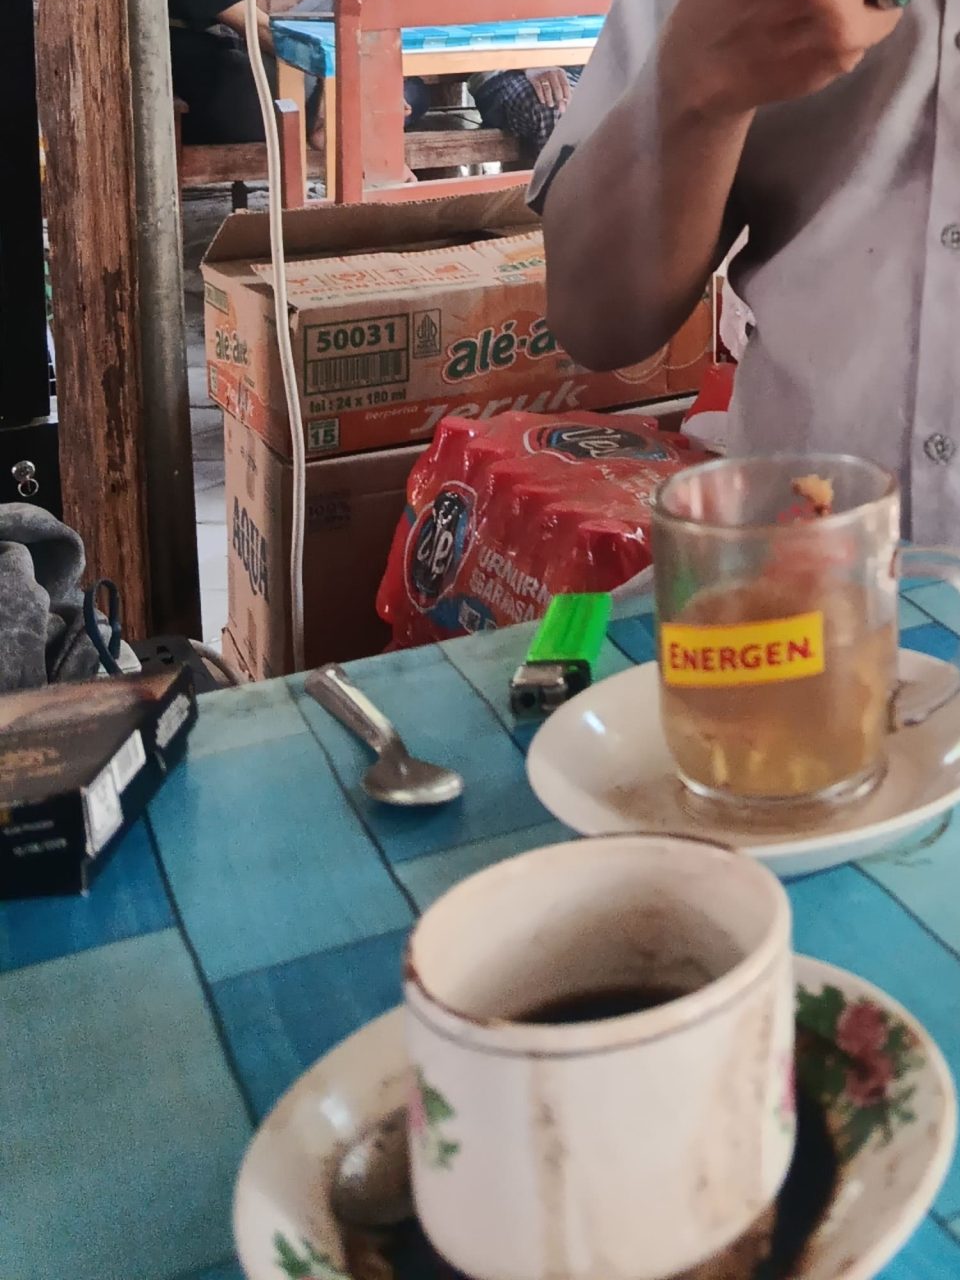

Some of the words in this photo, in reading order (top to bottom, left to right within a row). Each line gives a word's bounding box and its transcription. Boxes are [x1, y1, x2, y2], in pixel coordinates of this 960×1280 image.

[317, 323, 396, 352] 50031
[442, 319, 560, 382] alé-a
[337, 396, 351, 410] 24
[367, 391, 388, 405] 180
[311, 429, 337, 447] 15
[233, 496, 269, 604] AQUA
[669, 637, 812, 671] ENERGEN
